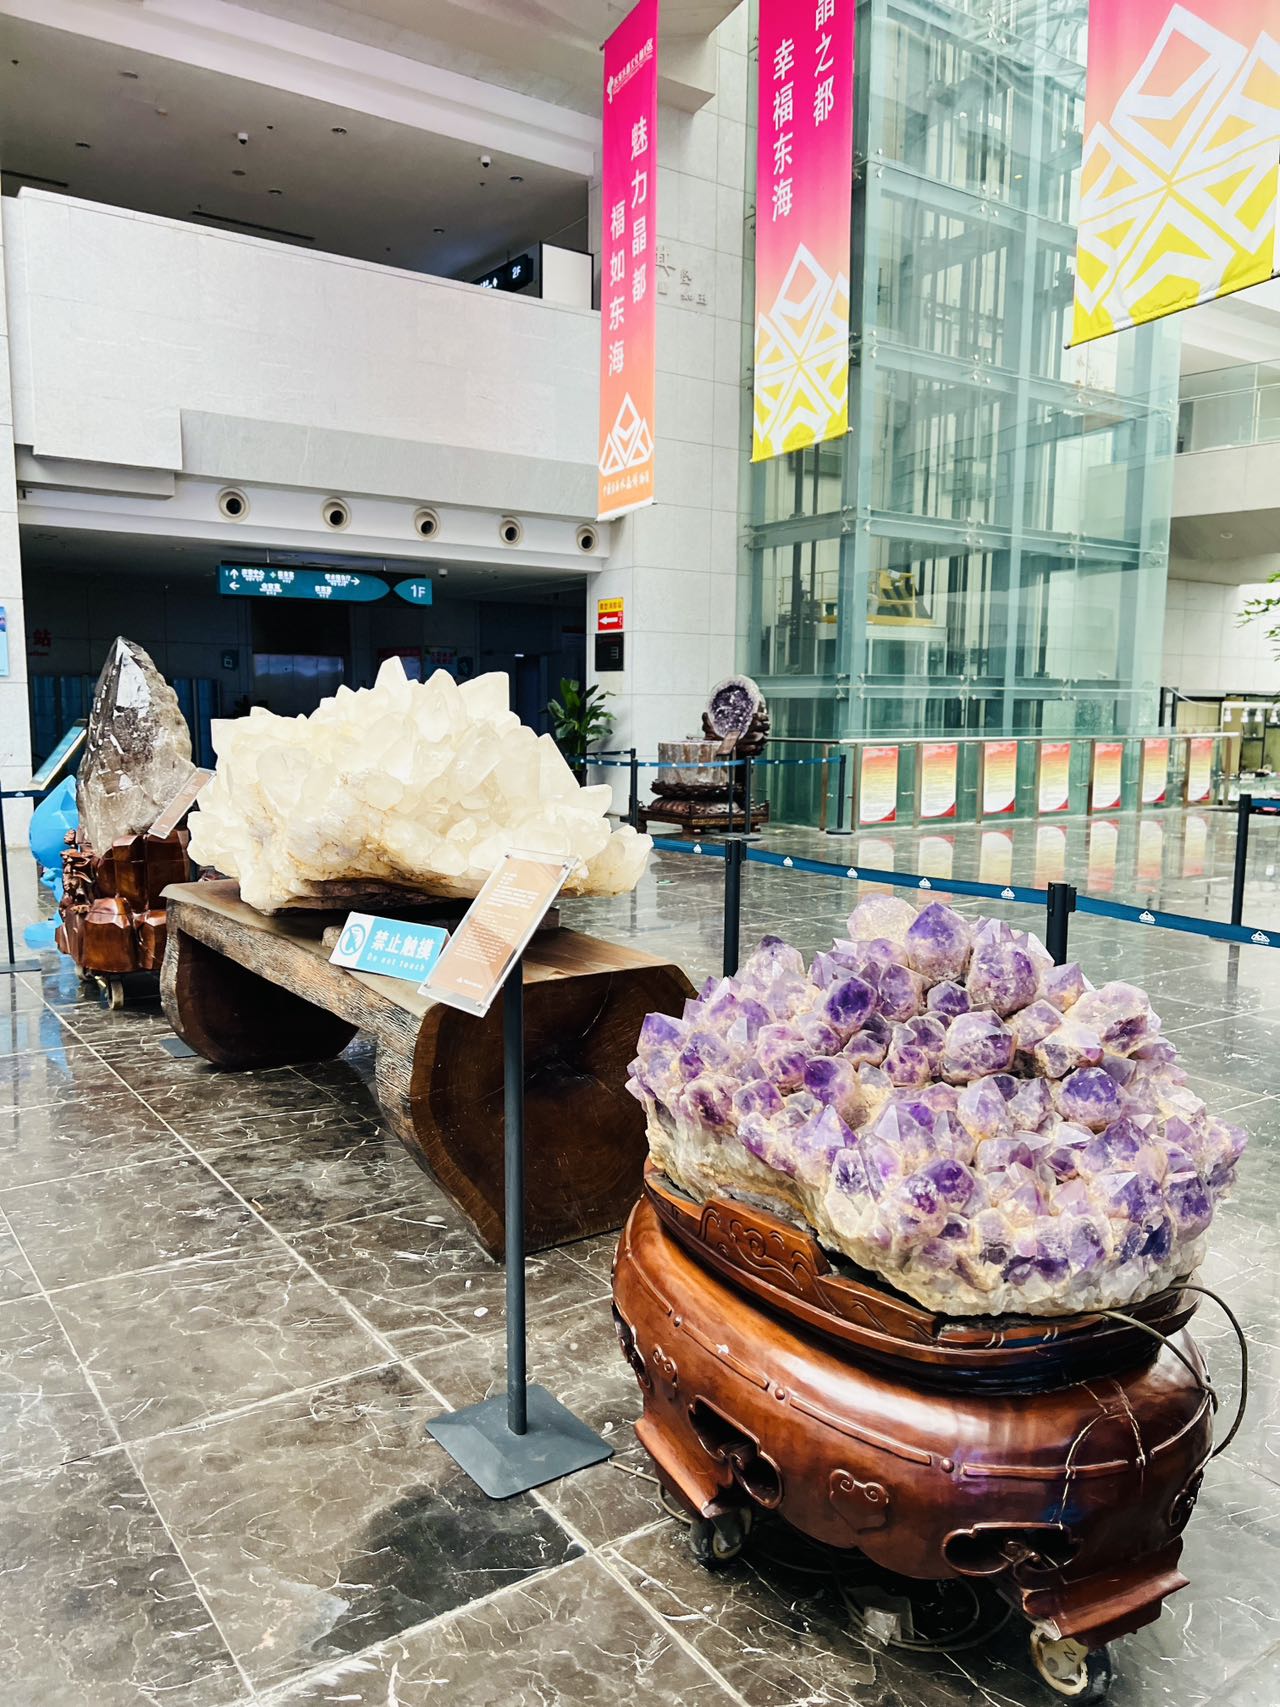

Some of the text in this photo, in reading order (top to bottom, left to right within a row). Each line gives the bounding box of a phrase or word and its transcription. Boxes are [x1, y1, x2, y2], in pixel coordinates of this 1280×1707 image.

[772, 38, 794, 222] 幸福东海
[631, 116, 648, 303] 魅力晶都
[512, 265, 521, 279] 2F
[608, 200, 626, 376] 福如东海
[411, 584, 425, 598] 1F
[371, 929, 435, 960] 禁止触摸
